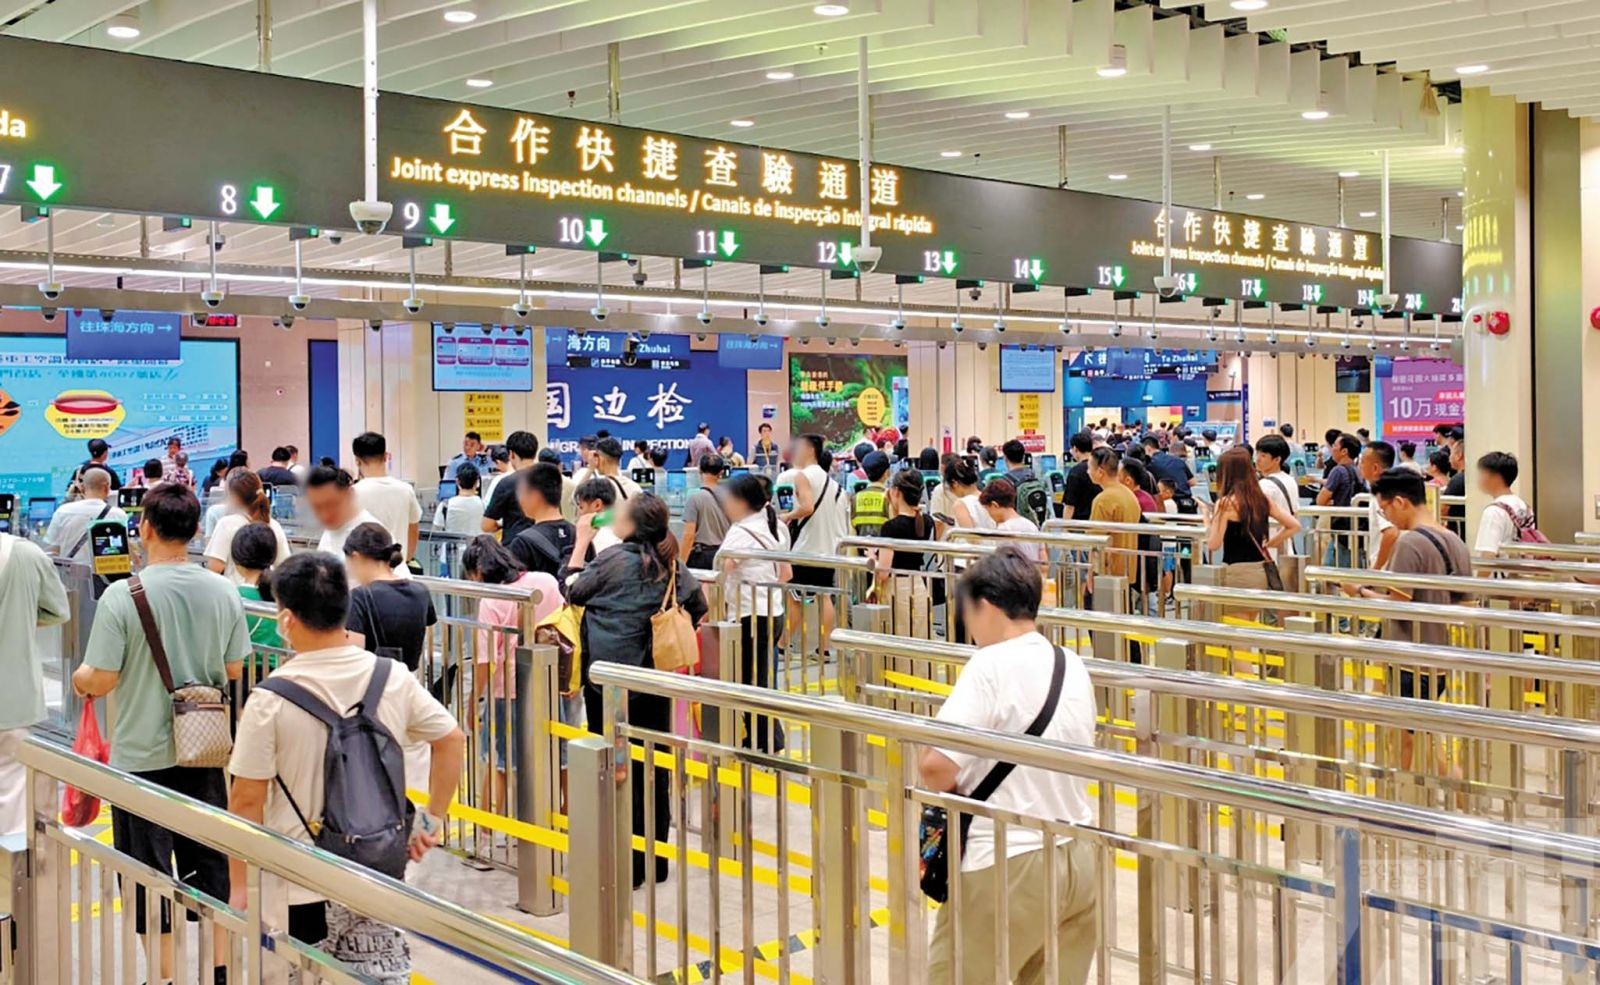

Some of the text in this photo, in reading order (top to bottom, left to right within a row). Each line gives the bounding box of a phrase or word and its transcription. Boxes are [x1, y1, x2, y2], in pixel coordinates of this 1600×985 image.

[443, 108, 899, 206] 合作快捷查驗通道
[0, 164, 12, 194] 7
[220, 184, 237, 215] 8
[391, 156, 443, 182] Joint
[446, 164, 520, 191] express
[616, 182, 689, 209] channels
[701, 194, 751, 217] Canais
[753, 198, 773, 218] de
[842, 207, 891, 233] intgral
[893, 211, 932, 236] rápida
[403, 202, 420, 230] 9
[558, 216, 584, 243] 10
[696, 230, 717, 255] 11
[817, 241, 837, 264] 12
[923, 251, 941, 273] 13
[1013, 258, 1030, 280] 14
[1097, 265, 1112, 286] 15
[1241, 279, 1253, 296] 17
[1302, 284, 1313, 302] 18
[79, 320, 154, 334] 往珠海方向
[567, 333, 611, 353] 海方向
[638, 344, 671, 354] Zhuhai
[547, 382, 693, 430] 国边检
[1388, 396, 1465, 419] 10万现金
